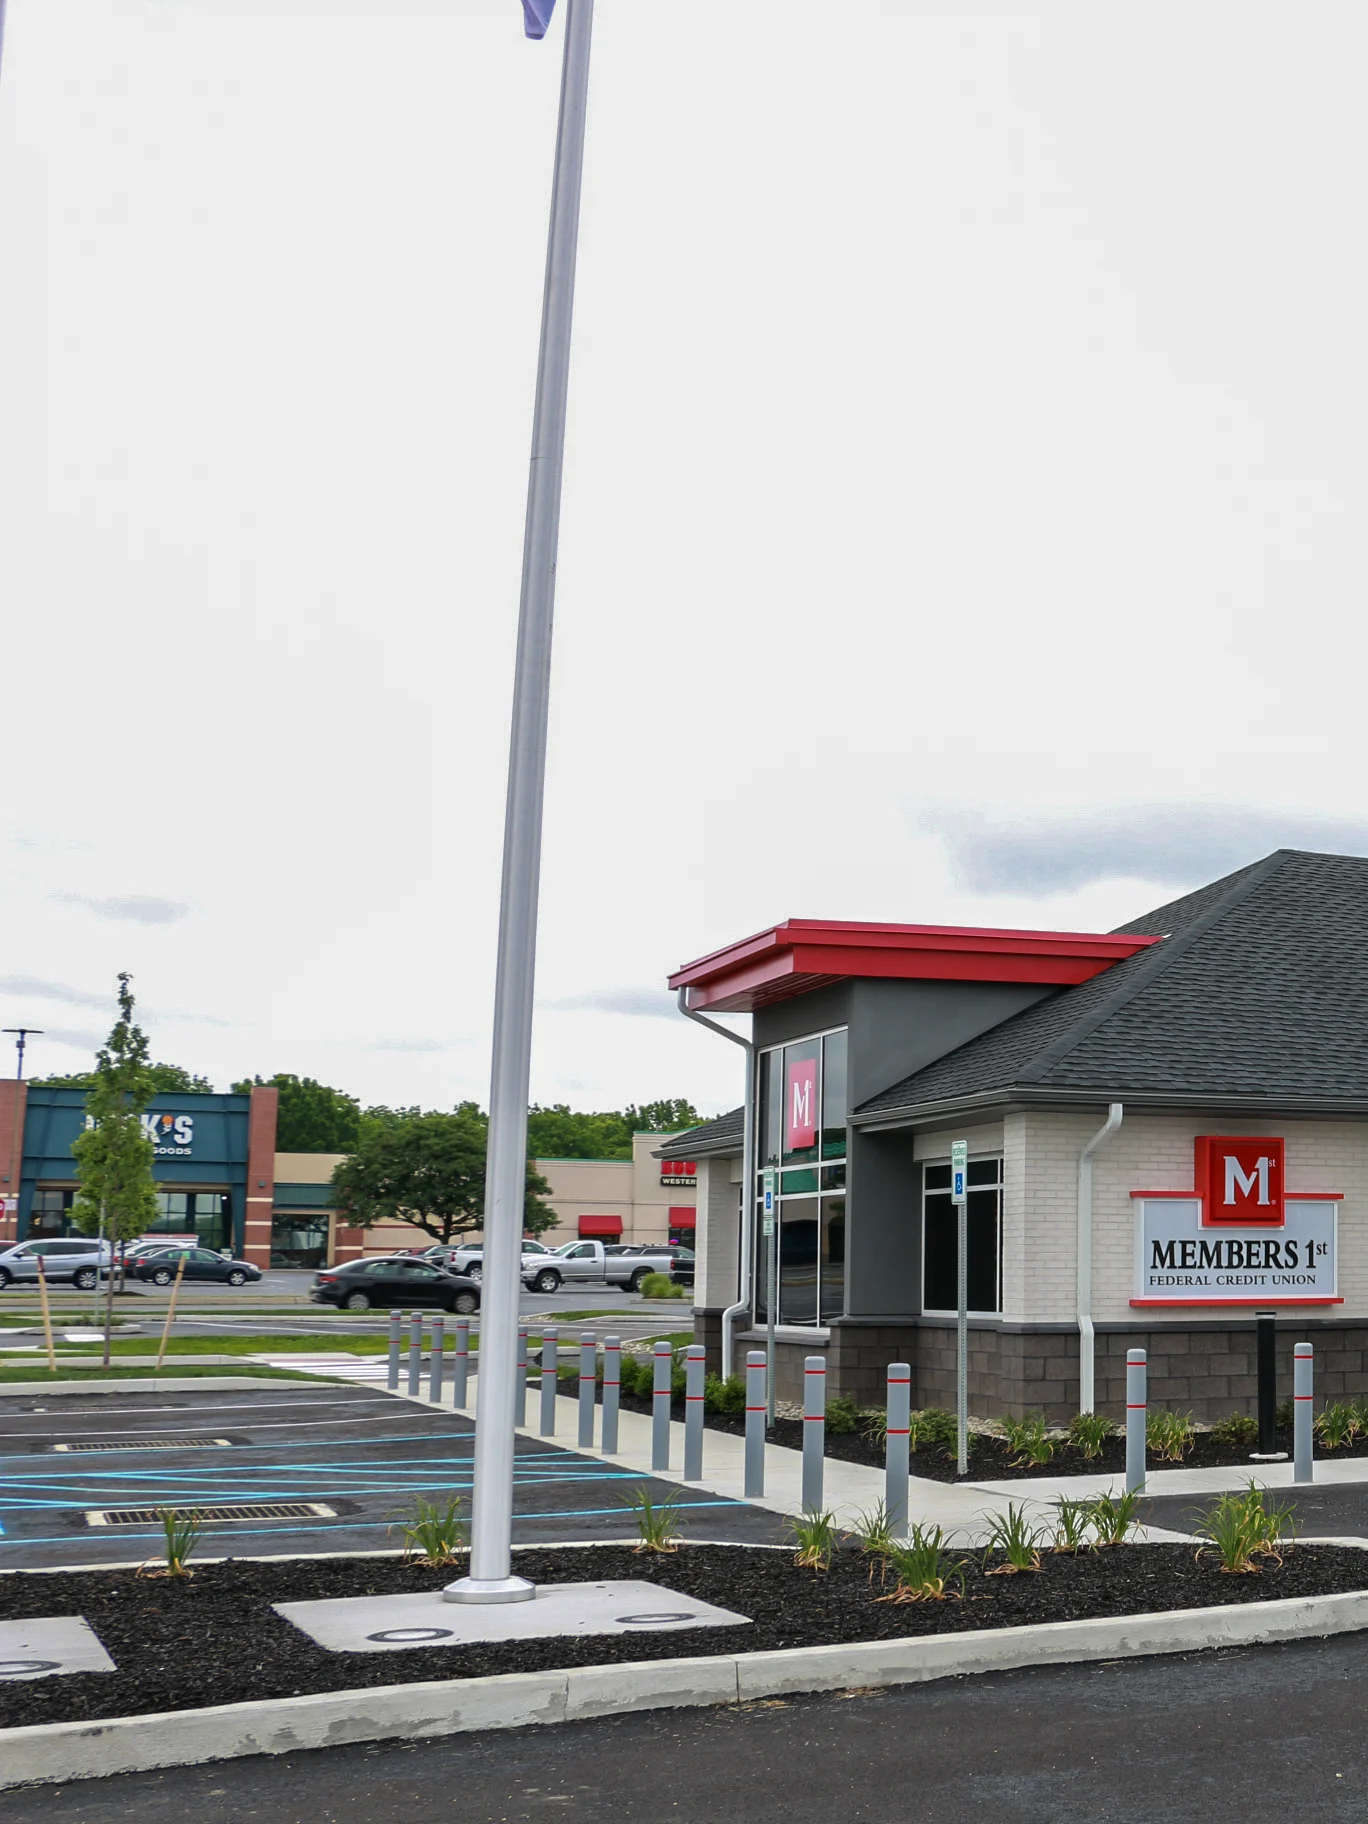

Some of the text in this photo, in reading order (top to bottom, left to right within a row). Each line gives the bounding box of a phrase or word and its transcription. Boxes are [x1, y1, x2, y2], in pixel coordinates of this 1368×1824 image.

[1150, 1239, 1328, 1269] MEMBERS 1st
[1150, 1275, 1316, 1286] FEDERAL CREDIT UNION
